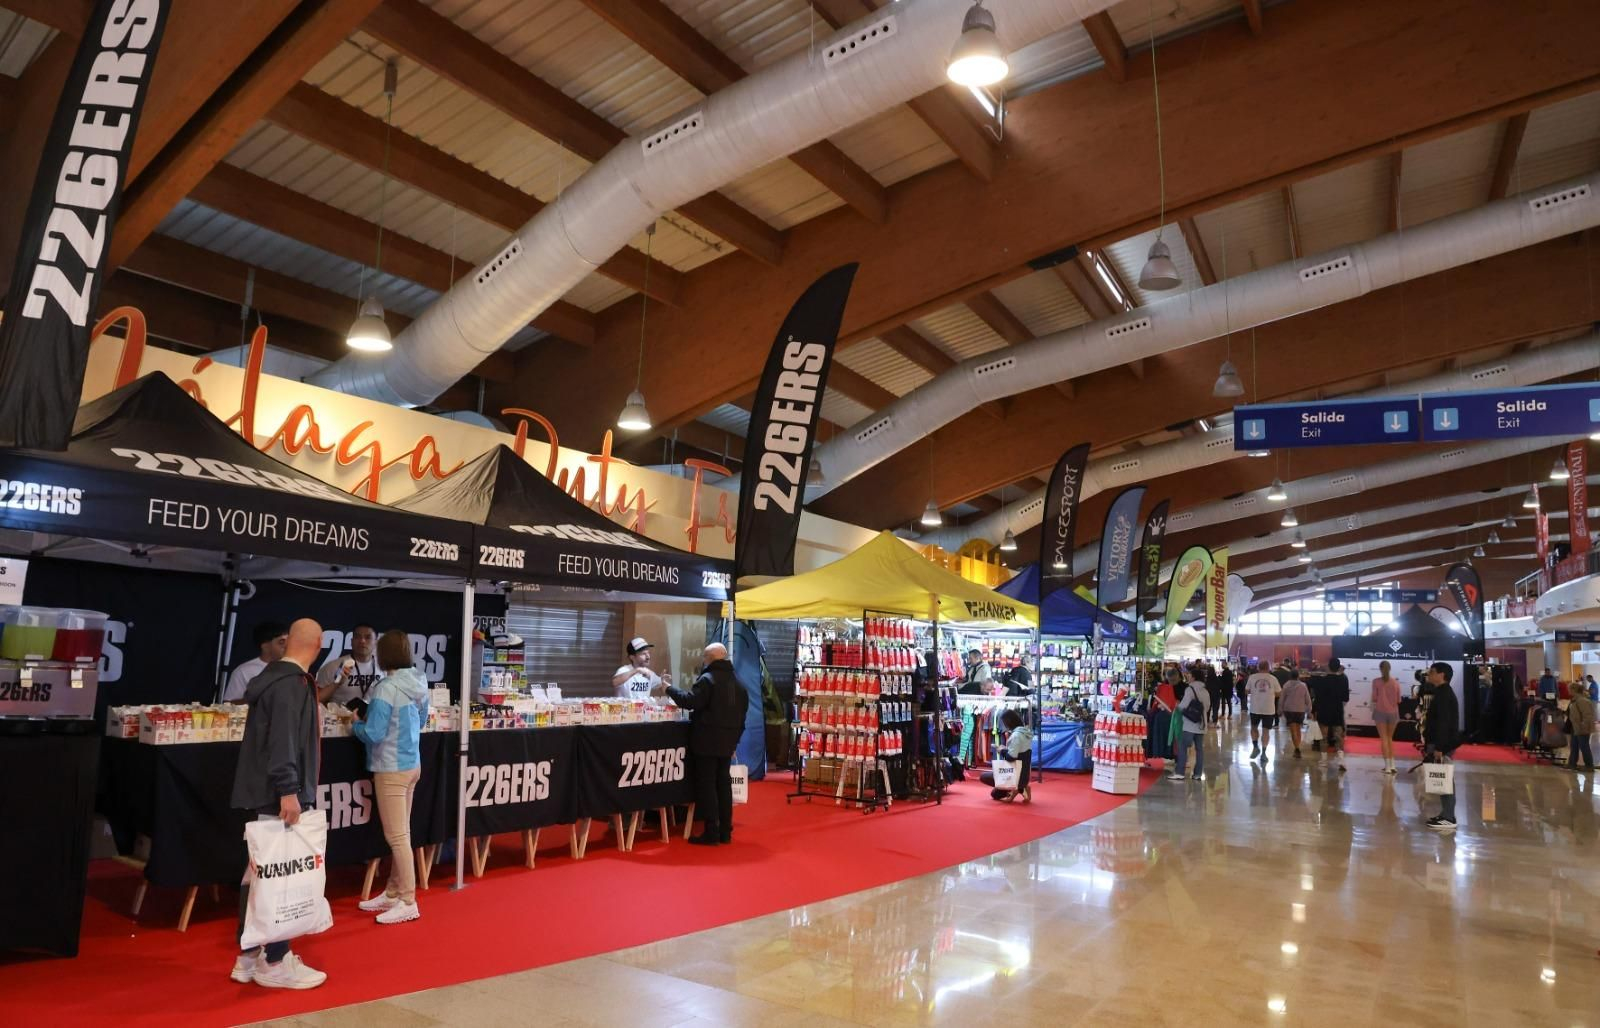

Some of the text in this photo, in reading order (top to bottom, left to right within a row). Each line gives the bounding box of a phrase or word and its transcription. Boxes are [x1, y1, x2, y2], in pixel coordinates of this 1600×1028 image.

[22, 0, 161, 327] 226ERS
[1301, 411, 1345, 423] Salida
[1496, 400, 1547, 414] Salida
[1497, 416, 1521, 429] Exit
[754, 341, 827, 515] 226ERS
[1301, 427, 1322, 438] Exit
[1570, 446, 1584, 515] GENERALI
[148, 498, 370, 551] FEED YOUR DREAMS
[409, 537, 460, 561] 226ERS
[479, 545, 526, 569] 226ERS
[1107, 525, 1123, 582] VICTORY
[558, 553, 680, 585] FEED YOUR DREAMS
[702, 571, 732, 589] 226ERS
[1210, 562, 1226, 630] PowerBar
[1363, 651, 1429, 659] RONHILL
[0, 682, 52, 702] 26ERS
[618, 746, 687, 788] 226ERS
[465, 760, 551, 808] 226ERS
[316, 779, 373, 830] ERS
